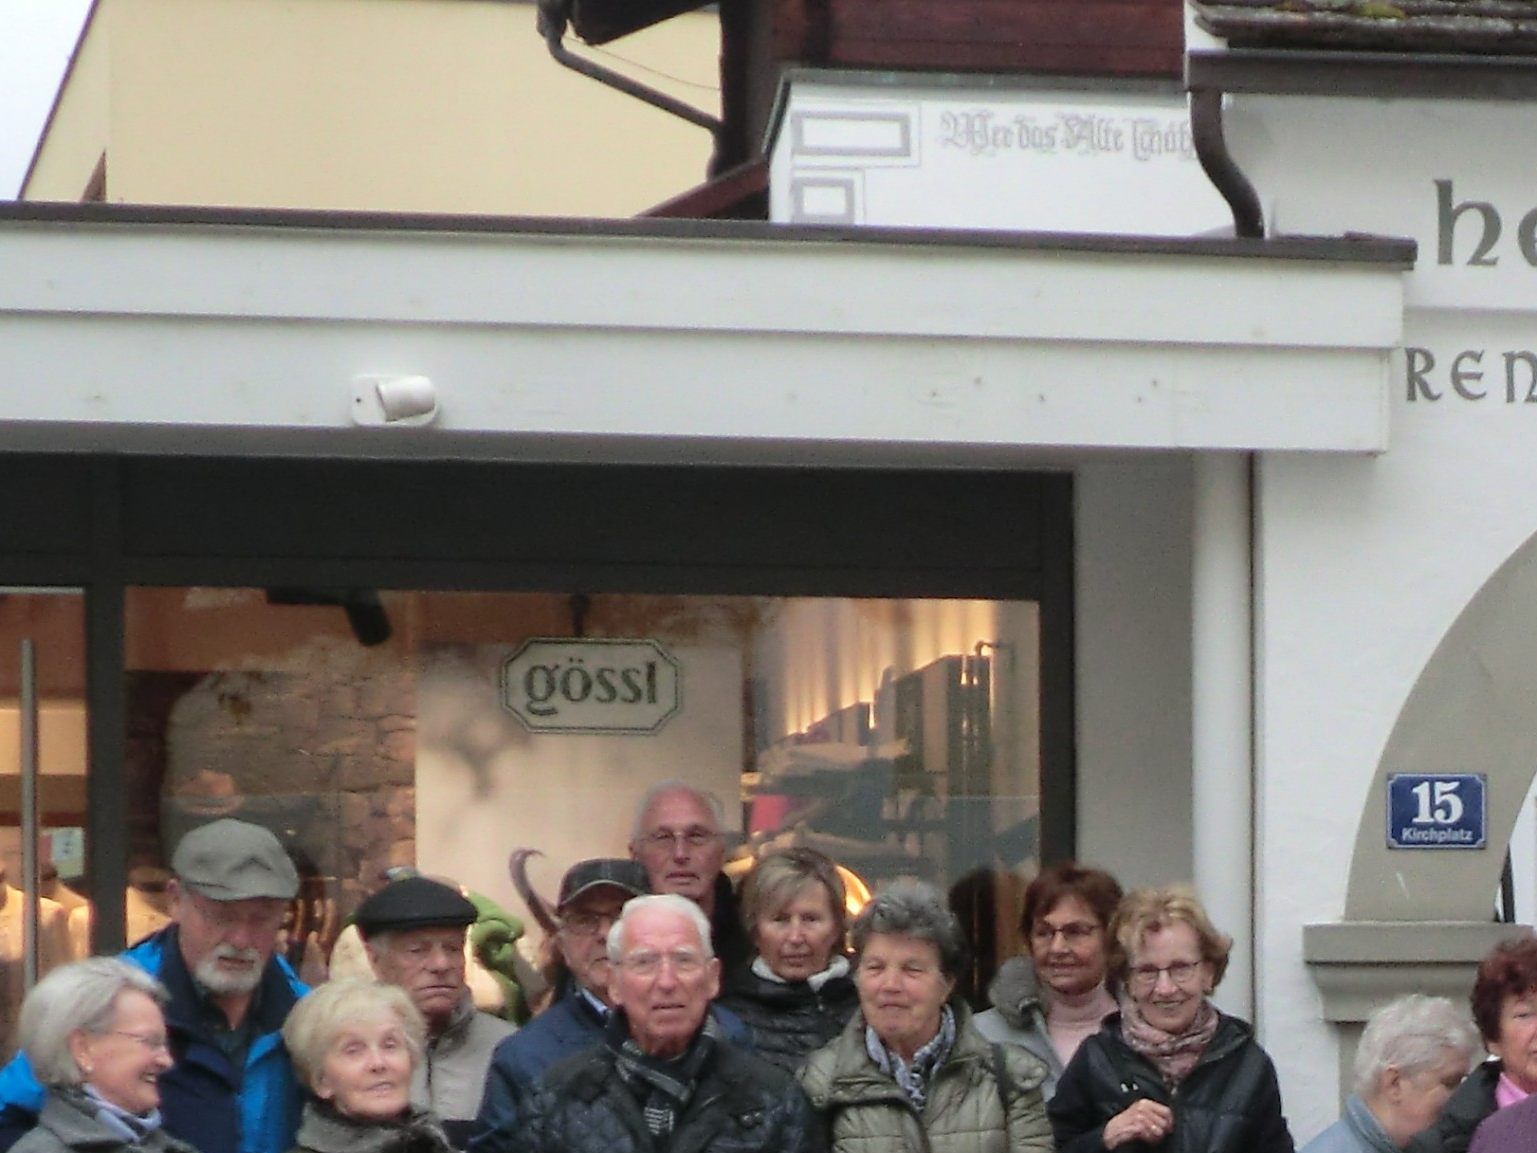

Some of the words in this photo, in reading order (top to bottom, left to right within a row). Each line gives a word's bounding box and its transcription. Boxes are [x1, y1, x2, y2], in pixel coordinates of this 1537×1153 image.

[1012, 114, 1058, 154] das
[524, 656, 657, 717] gössl
[1411, 780, 1464, 824] 15
[1401, 827, 1474, 844] Kirchplatz
